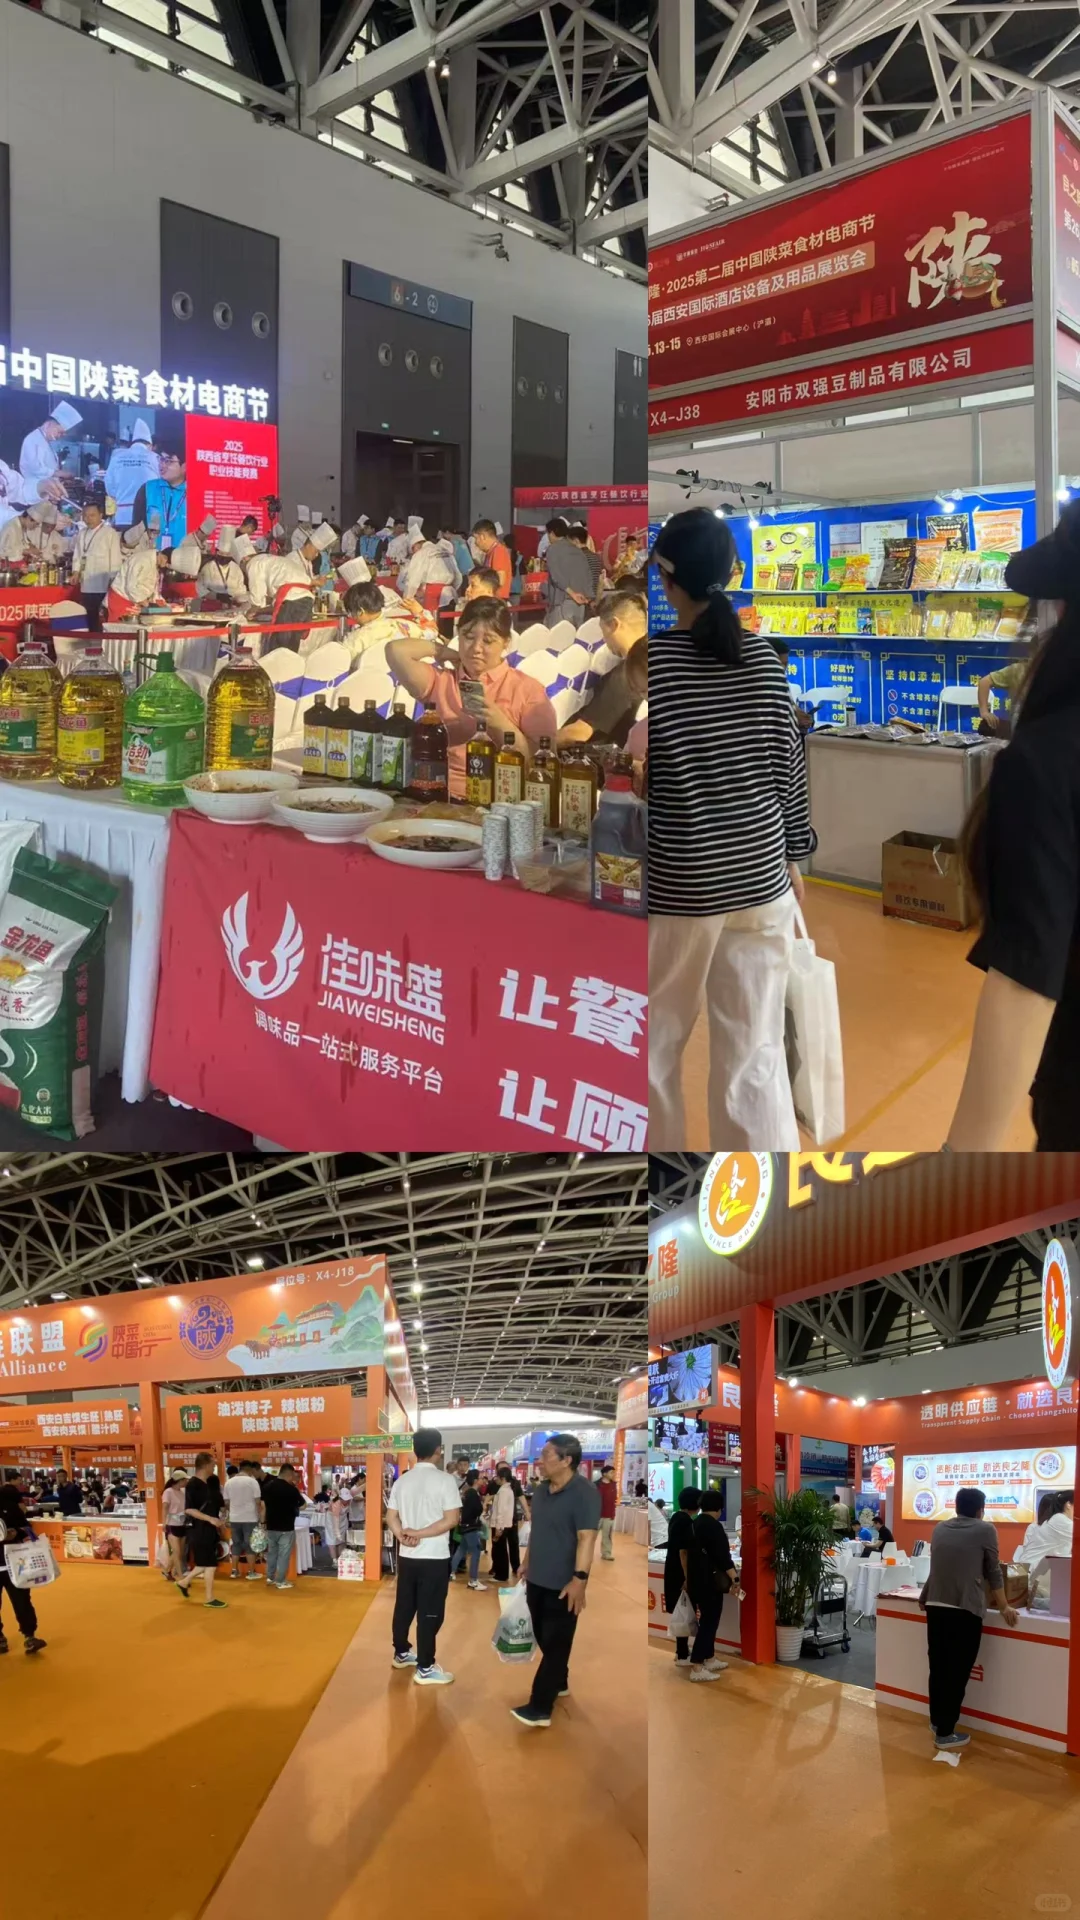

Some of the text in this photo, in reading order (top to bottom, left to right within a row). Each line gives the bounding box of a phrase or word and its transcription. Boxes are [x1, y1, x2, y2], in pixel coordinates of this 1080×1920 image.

[745, 346, 973, 411] 安阳市双强豆制品有限公司
[650, 404, 701, 428] X4-J38
[223, 440, 244, 453] 2025
[830, 663, 855, 674] 好腐竹
[1, 925, 55, 965] 金龙鱼
[320, 933, 446, 1023] 佳味盛
[317, 990, 445, 1046] JIAWEISHENG
[498, 967, 648, 1059] 让餐
[254, 1006, 444, 1095] 调味品一站式服务平台
[316, 1266, 355, 1281] X4-J18
[652, 1284, 680, 1304] Group
[0, 1359, 68, 1378] Alliance
[217, 1396, 325, 1417] 油泼辣子 辣椒粉
[920, 1386, 1080, 1421] 透明供应链·就选良
[241, 1417, 299, 1433] 陕味调料
[921, 1420, 957, 1429] Transparent
[958, 1417, 980, 1427] Supply
[981, 1414, 1001, 1423] Chain
[1008, 1411, 1035, 1420] Choose
